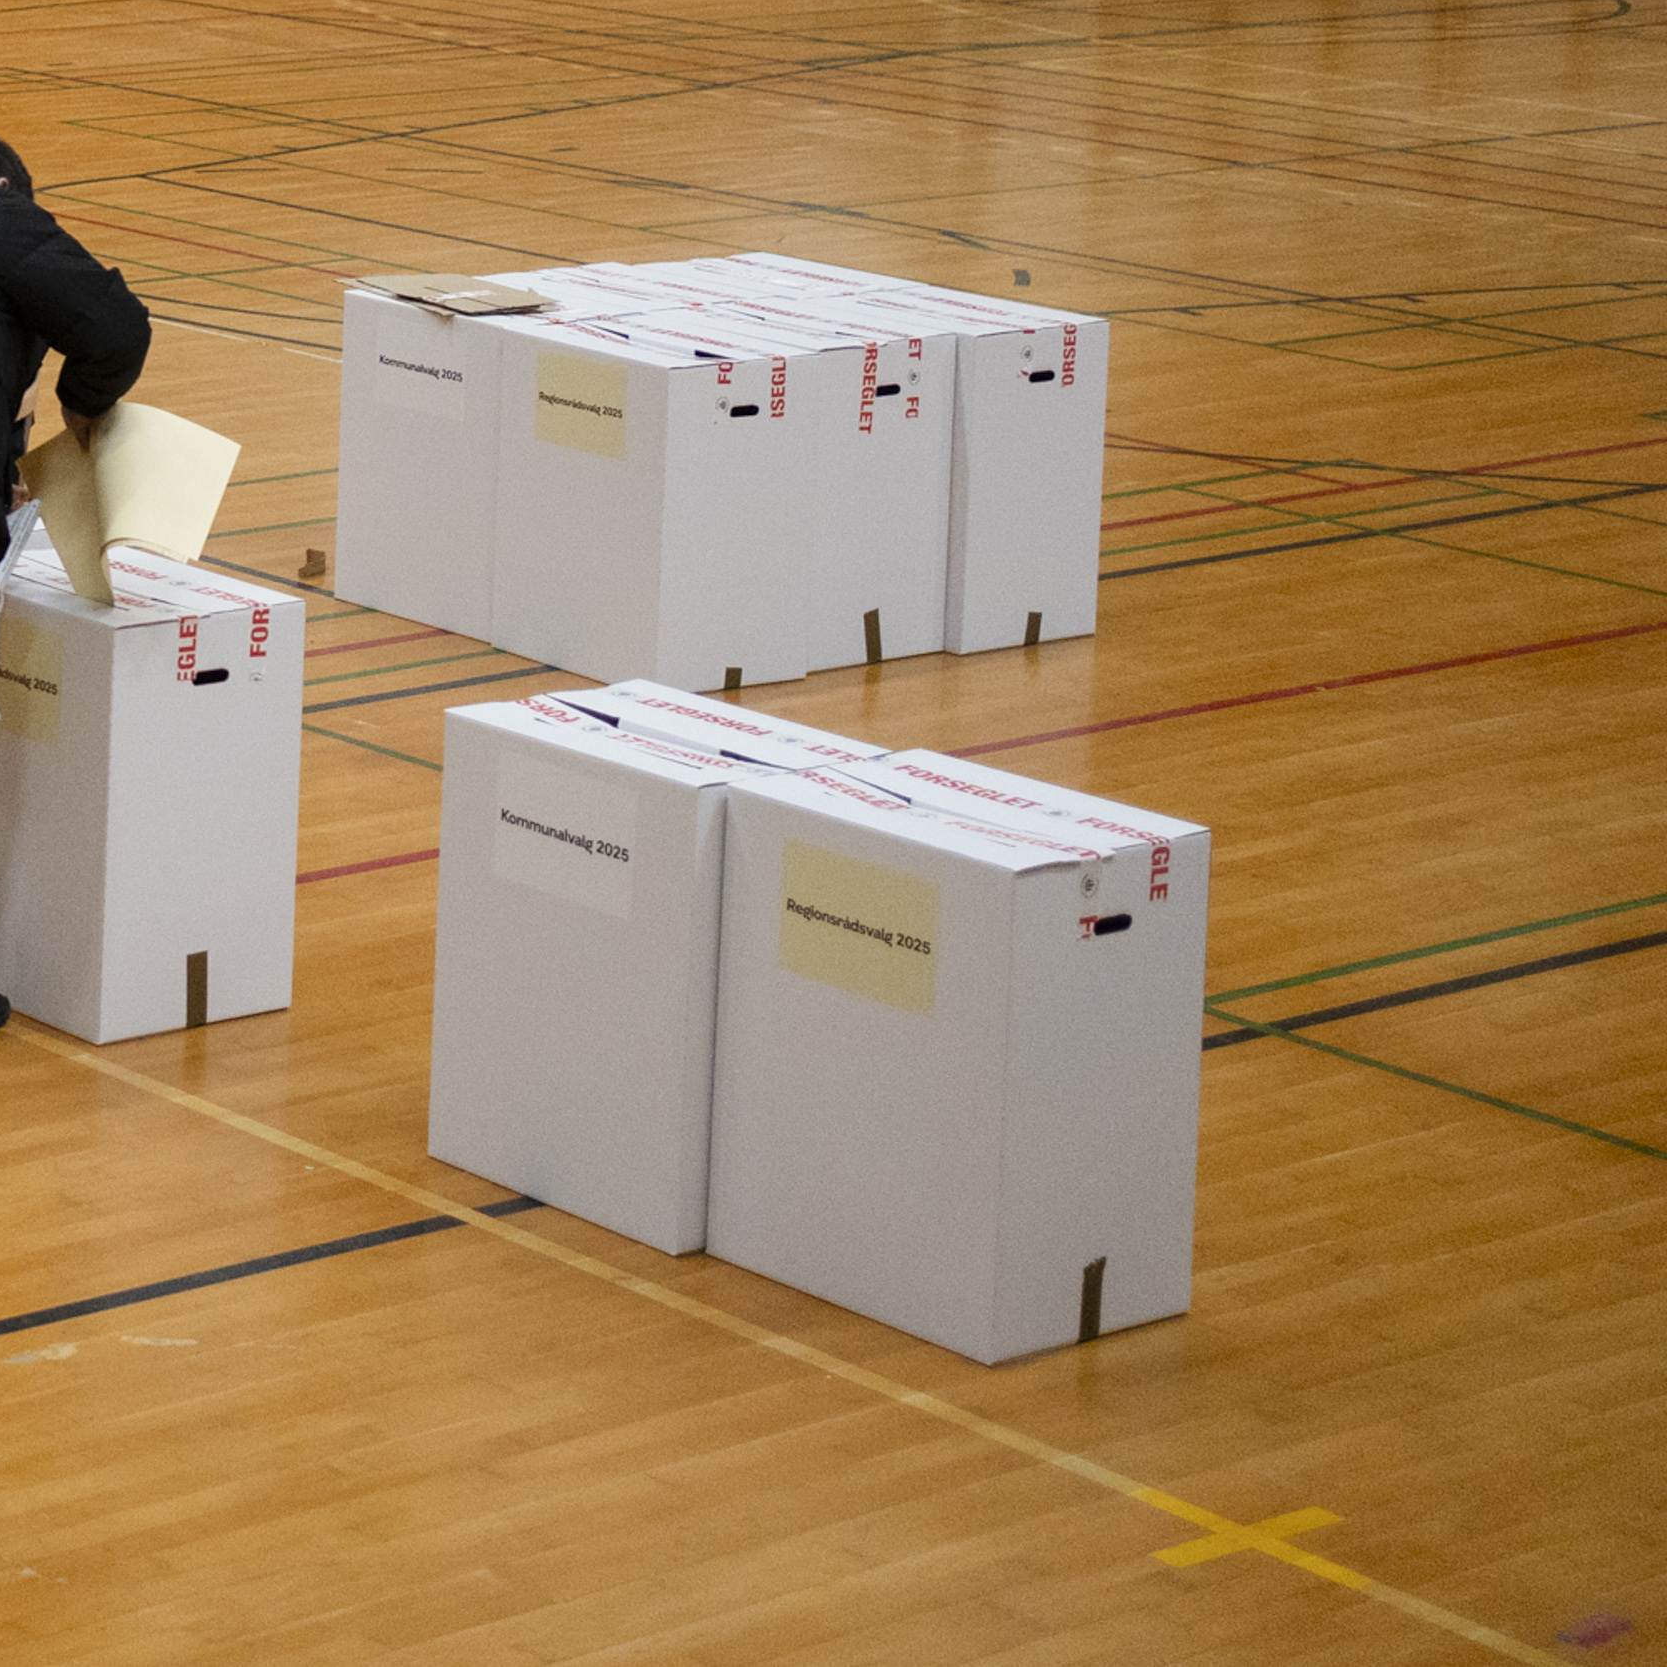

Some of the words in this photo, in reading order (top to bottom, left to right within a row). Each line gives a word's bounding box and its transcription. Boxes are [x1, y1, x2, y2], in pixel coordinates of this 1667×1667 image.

[379, 354, 440, 380] Kommunalvalg
[441, 368, 463, 382] 2025
[602, 405, 623, 419] 2025
[33, 676, 59, 695] 2025
[894, 764, 1044, 809] FORSEGLET
[500, 808, 594, 854] Kommunalvalg
[596, 840, 630, 863] 2025
[786, 897, 893, 947] Regionsrådsvalg
[896, 933, 932, 956] 2025
